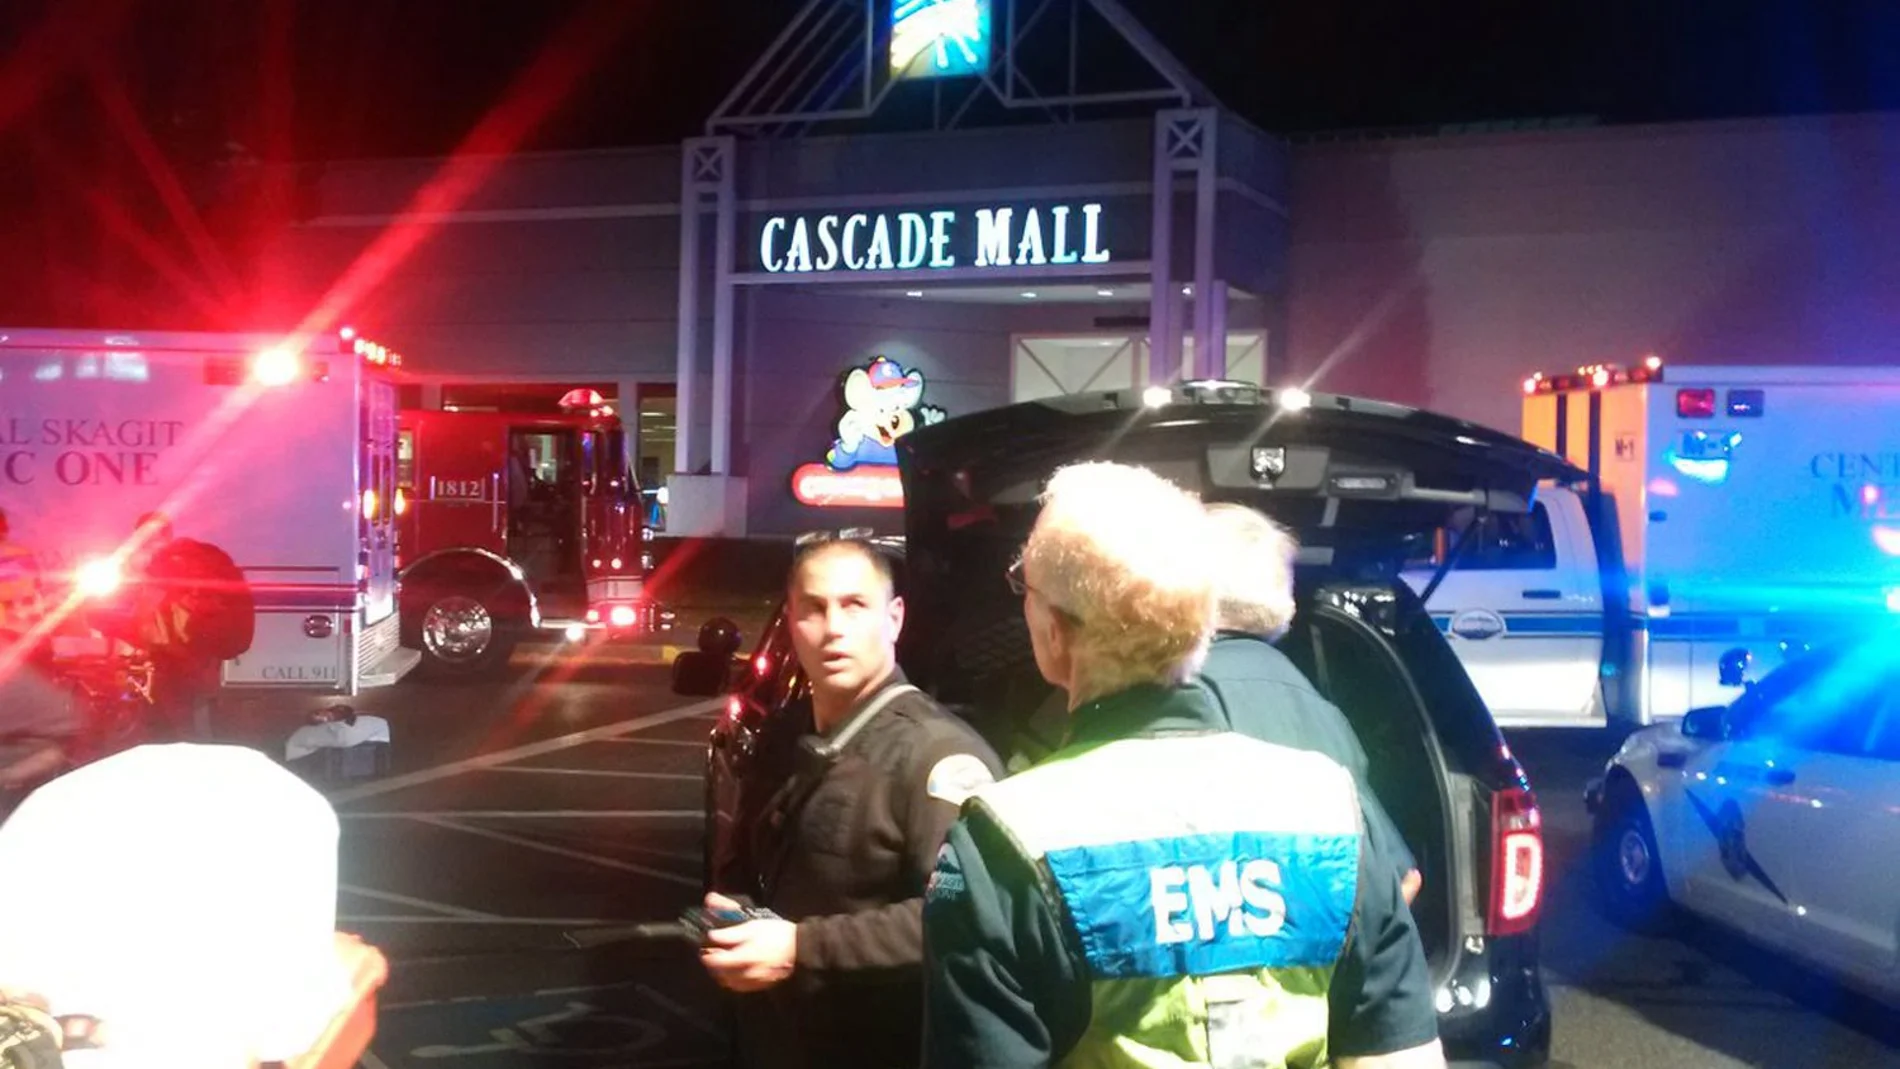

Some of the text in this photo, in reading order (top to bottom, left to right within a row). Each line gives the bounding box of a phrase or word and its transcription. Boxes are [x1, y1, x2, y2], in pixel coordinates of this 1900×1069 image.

[761, 204, 1110, 272] CASCADE MALL
[42, 419, 183, 447] SKAGIT
[55, 450, 158, 486] ONE
[437, 480, 480, 497] 1812
[261, 665, 336, 680] CALL 911
[1150, 858, 1287, 944] EMS
